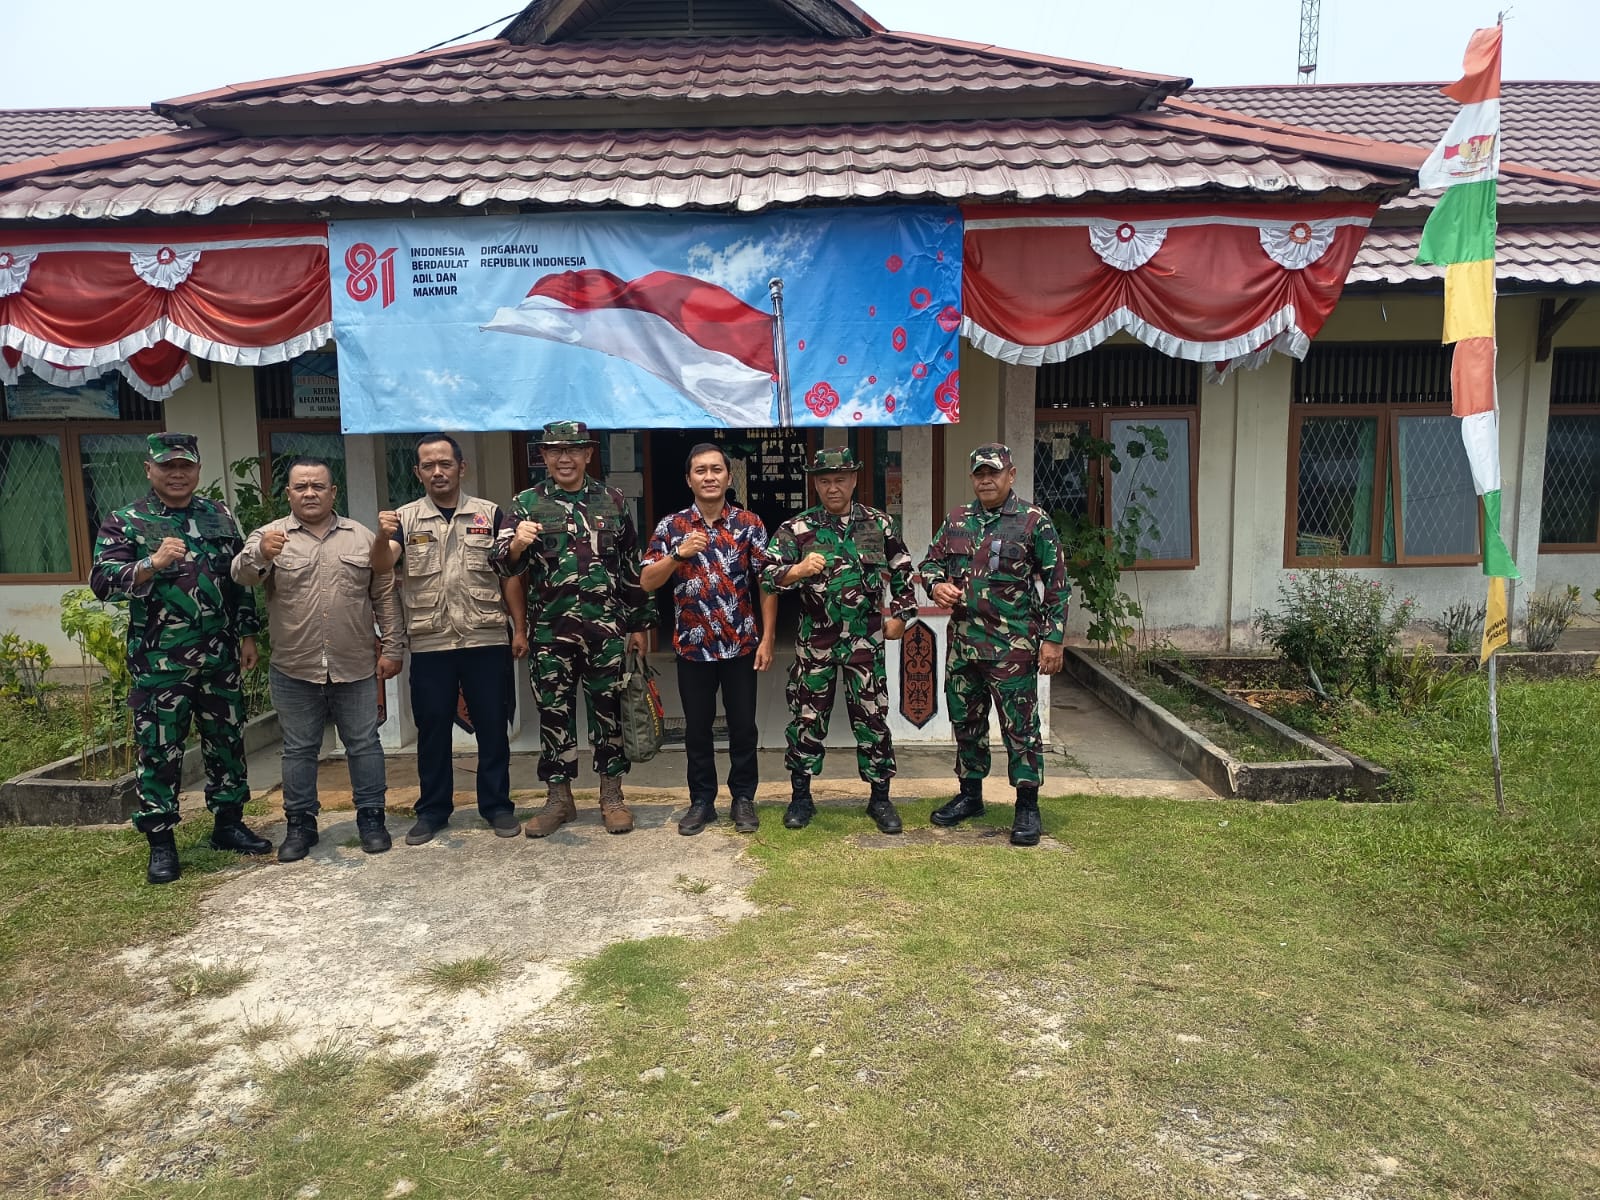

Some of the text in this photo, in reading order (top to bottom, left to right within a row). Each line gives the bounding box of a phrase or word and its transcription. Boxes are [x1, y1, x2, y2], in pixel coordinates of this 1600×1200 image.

[410, 246, 465, 257] INDONESIA
[480, 244, 538, 255] DIRGAHAYU
[412, 259, 469, 270] BERDAULAT
[480, 256, 587, 268] REPUBLIK INDONESIA
[344, 242, 399, 309] 81
[412, 272, 457, 284] ADIL DAN
[413, 285, 458, 297] MAKMUR
[312, 387, 338, 395] KELURA
